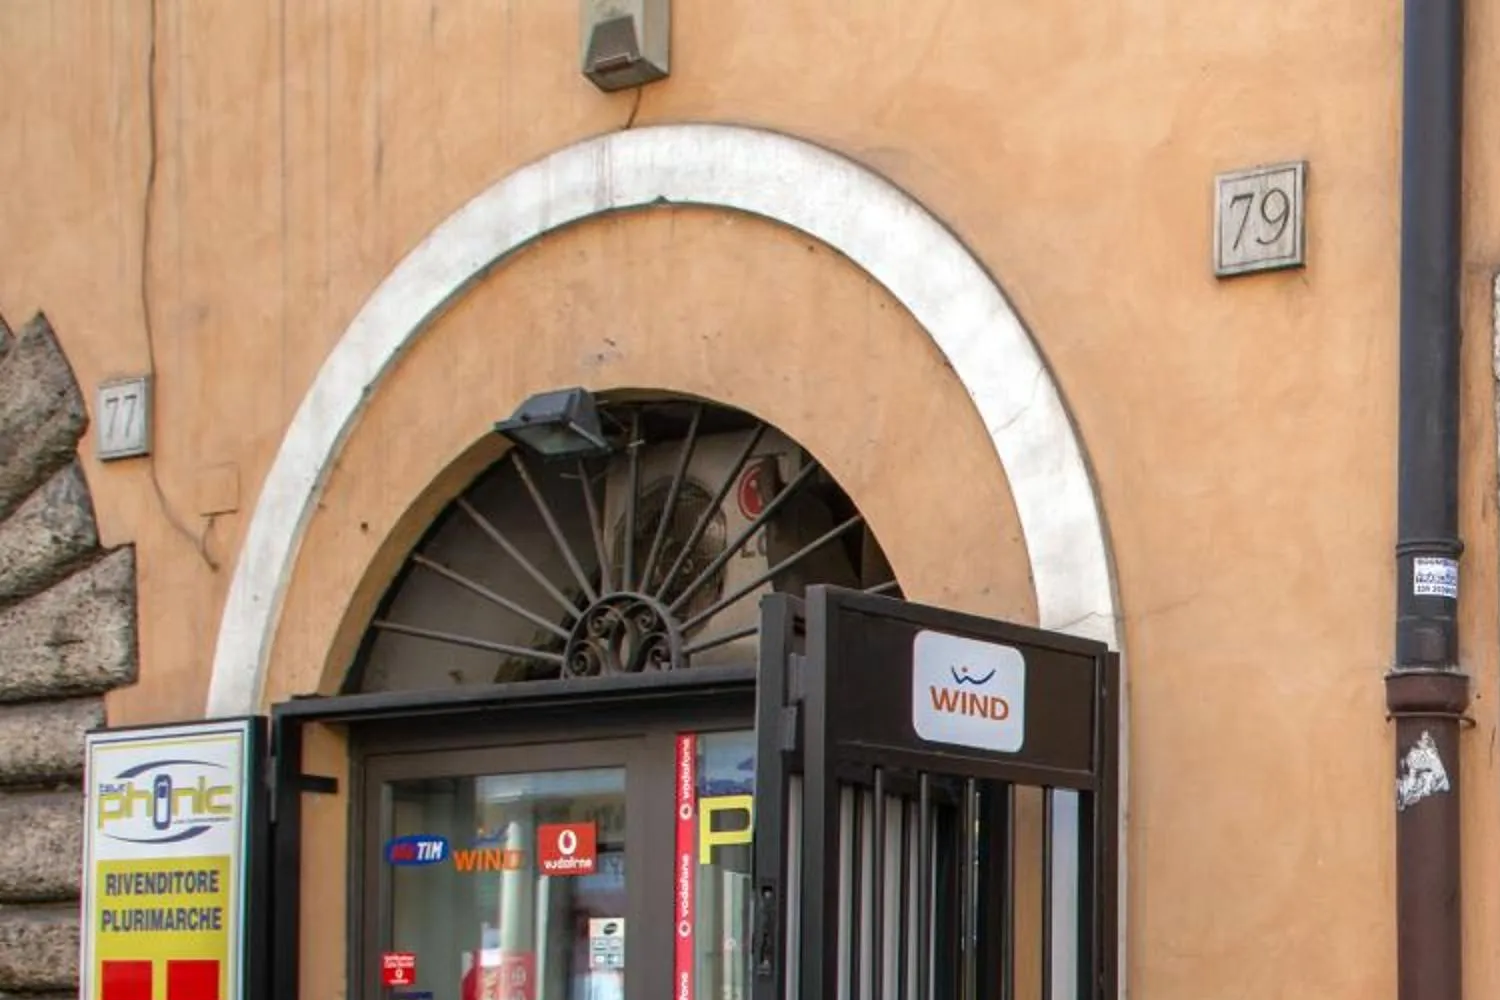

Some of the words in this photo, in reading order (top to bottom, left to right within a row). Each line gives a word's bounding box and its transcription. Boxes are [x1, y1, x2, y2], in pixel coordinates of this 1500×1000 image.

[1229, 187, 1290, 251] 79
[105, 394, 138, 440] 77
[929, 684, 1010, 721] WIND
[416, 841, 443, 861] TIM
[452, 847, 523, 872] WIND
[543, 857, 593, 870] vodafone
[105, 869, 220, 897] RIVENDITORE
[680, 853, 689, 918] vodafone
[101, 906, 223, 932] PLURIMARCHE
